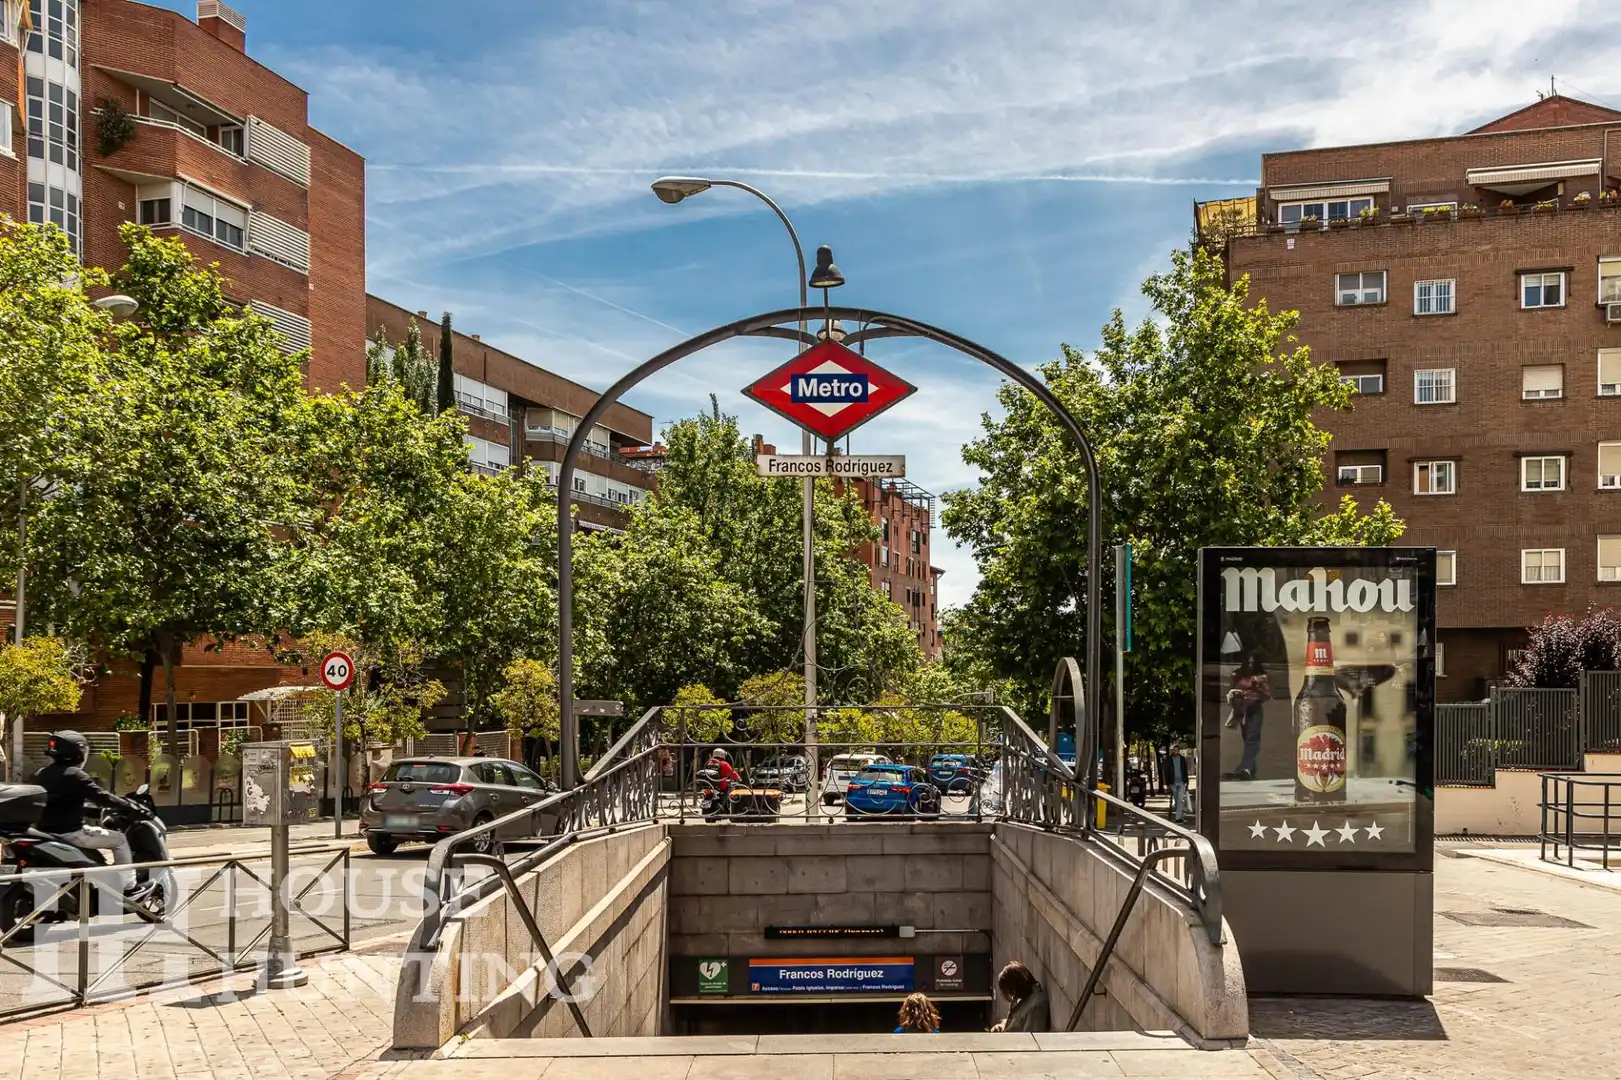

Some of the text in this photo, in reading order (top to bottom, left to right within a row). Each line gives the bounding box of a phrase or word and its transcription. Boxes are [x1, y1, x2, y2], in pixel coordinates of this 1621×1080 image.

[798, 378, 863, 397] Metro
[768, 458, 893, 475] Francos Rodríguez
[1221, 567, 1415, 613] Mahou
[327, 665, 347, 677] 40
[1300, 747, 1345, 761] Madrid
[779, 968, 884, 981] Francos Rodríguez
